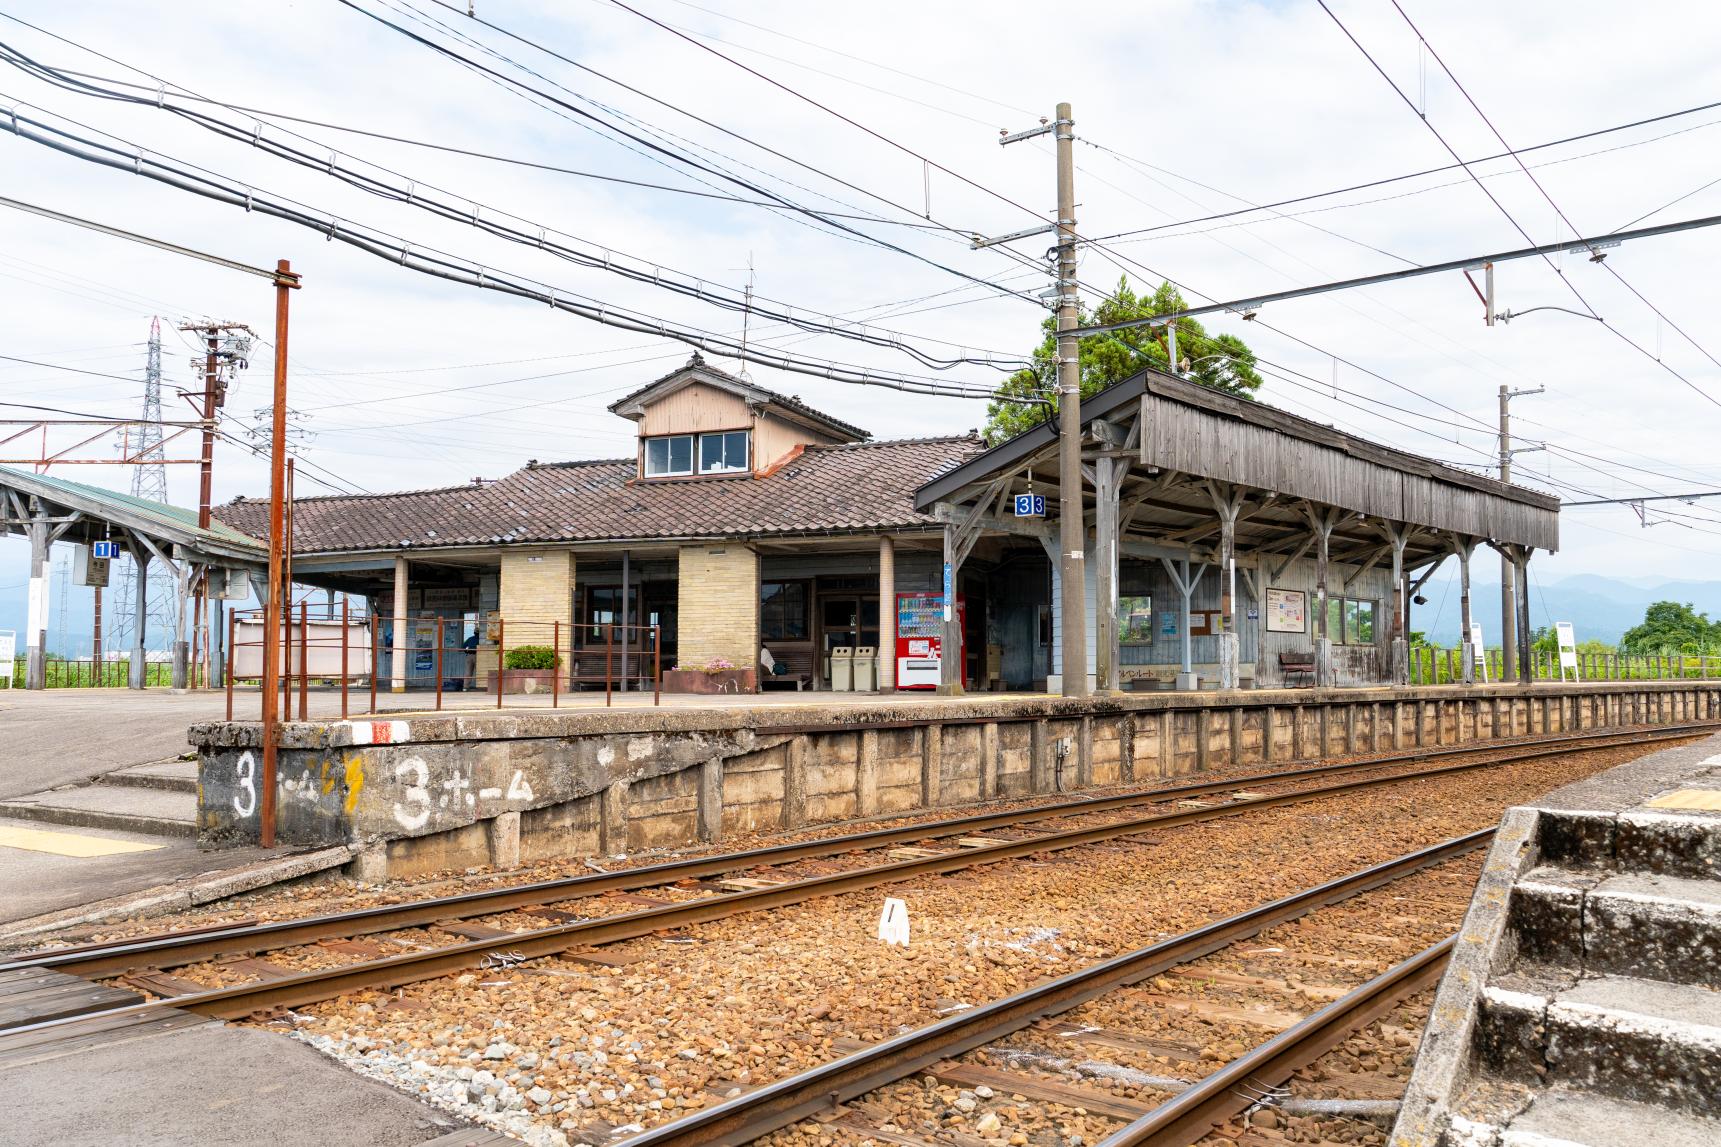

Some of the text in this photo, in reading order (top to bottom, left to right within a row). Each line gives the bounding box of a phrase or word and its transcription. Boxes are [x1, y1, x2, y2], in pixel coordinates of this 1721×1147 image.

[1020, 497, 1029, 513] 3
[1036, 497, 1043, 513] 3
[99, 543, 105, 556] 1
[113, 544, 117, 556] 1
[1119, 669, 1154, 678] ルペンルート
